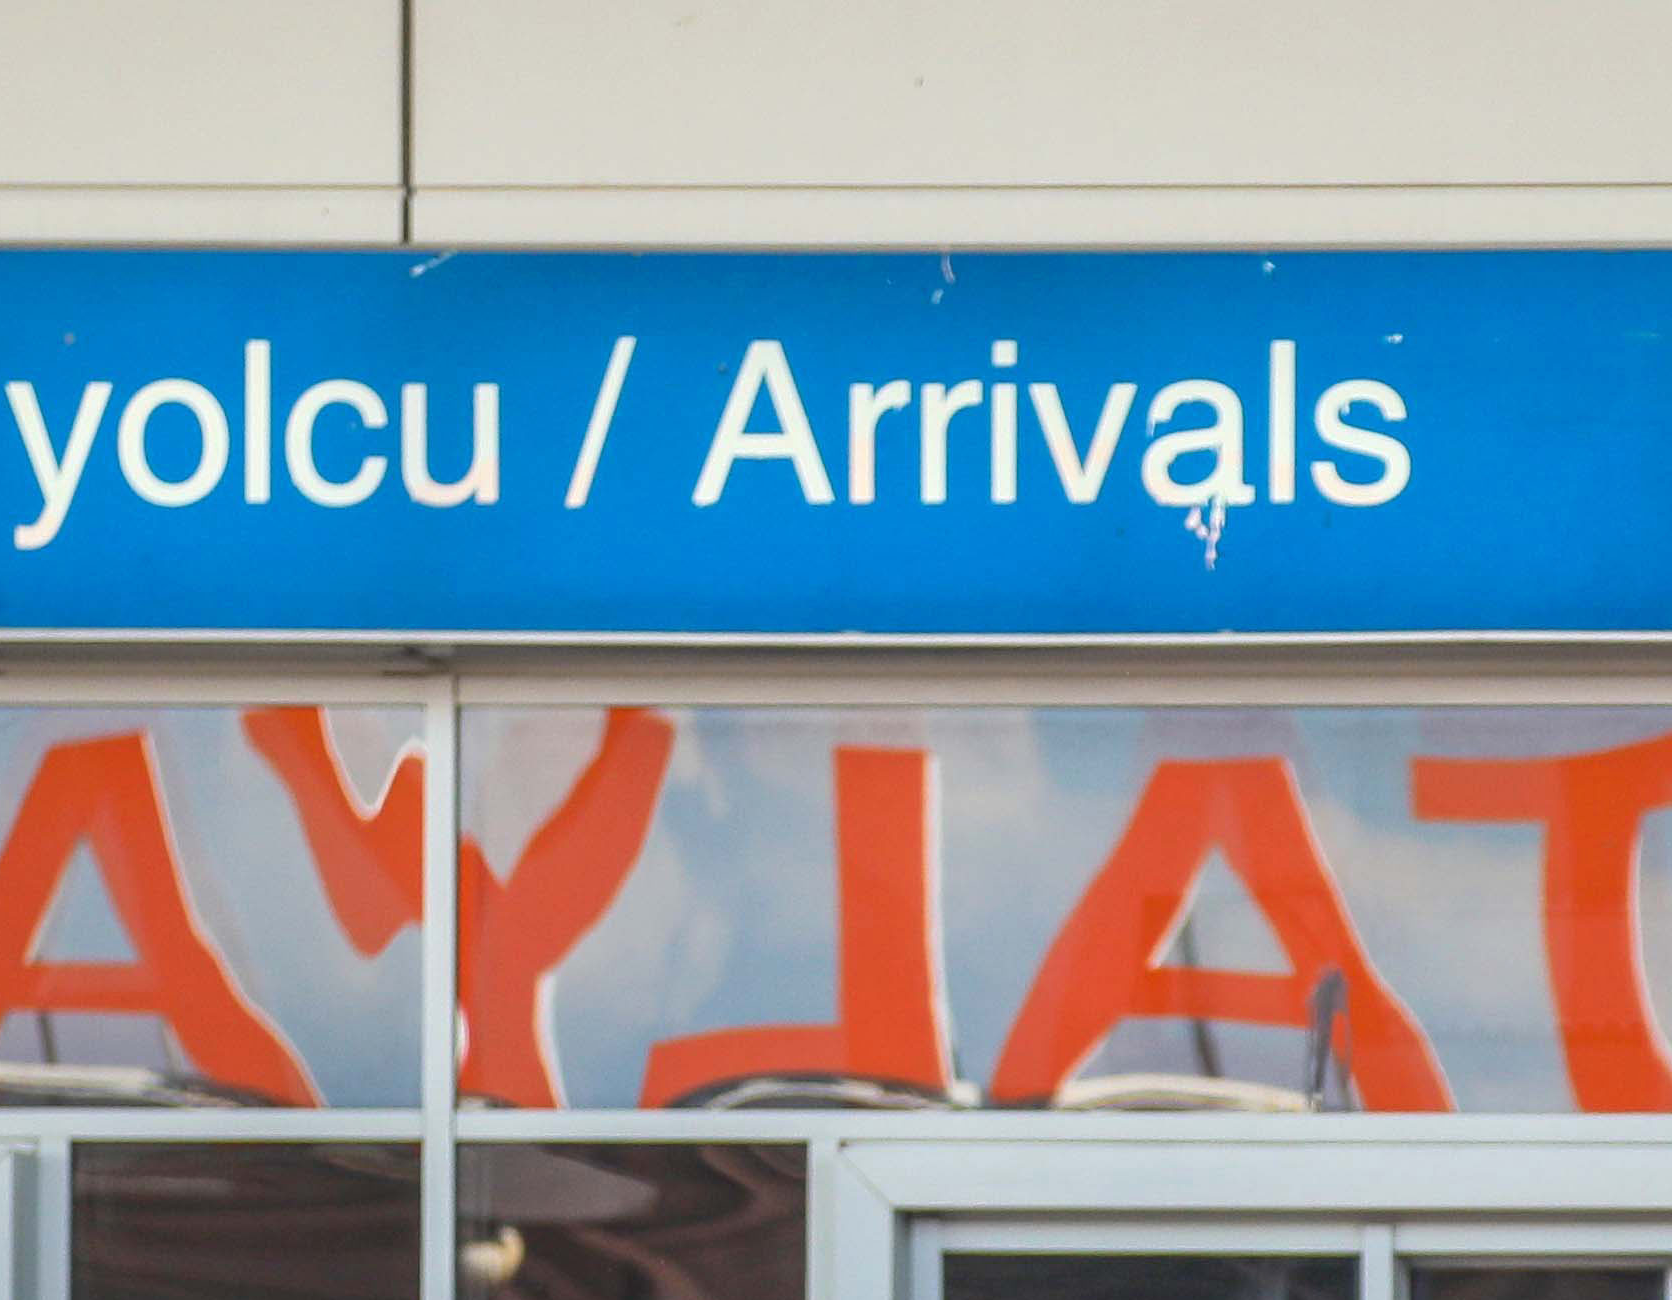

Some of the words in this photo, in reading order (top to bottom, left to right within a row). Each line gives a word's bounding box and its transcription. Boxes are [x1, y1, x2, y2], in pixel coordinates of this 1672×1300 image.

[5, 338, 500, 550] yolcu
[564, 335, 636, 509] /
[691, 338, 1413, 508] Arrivals
